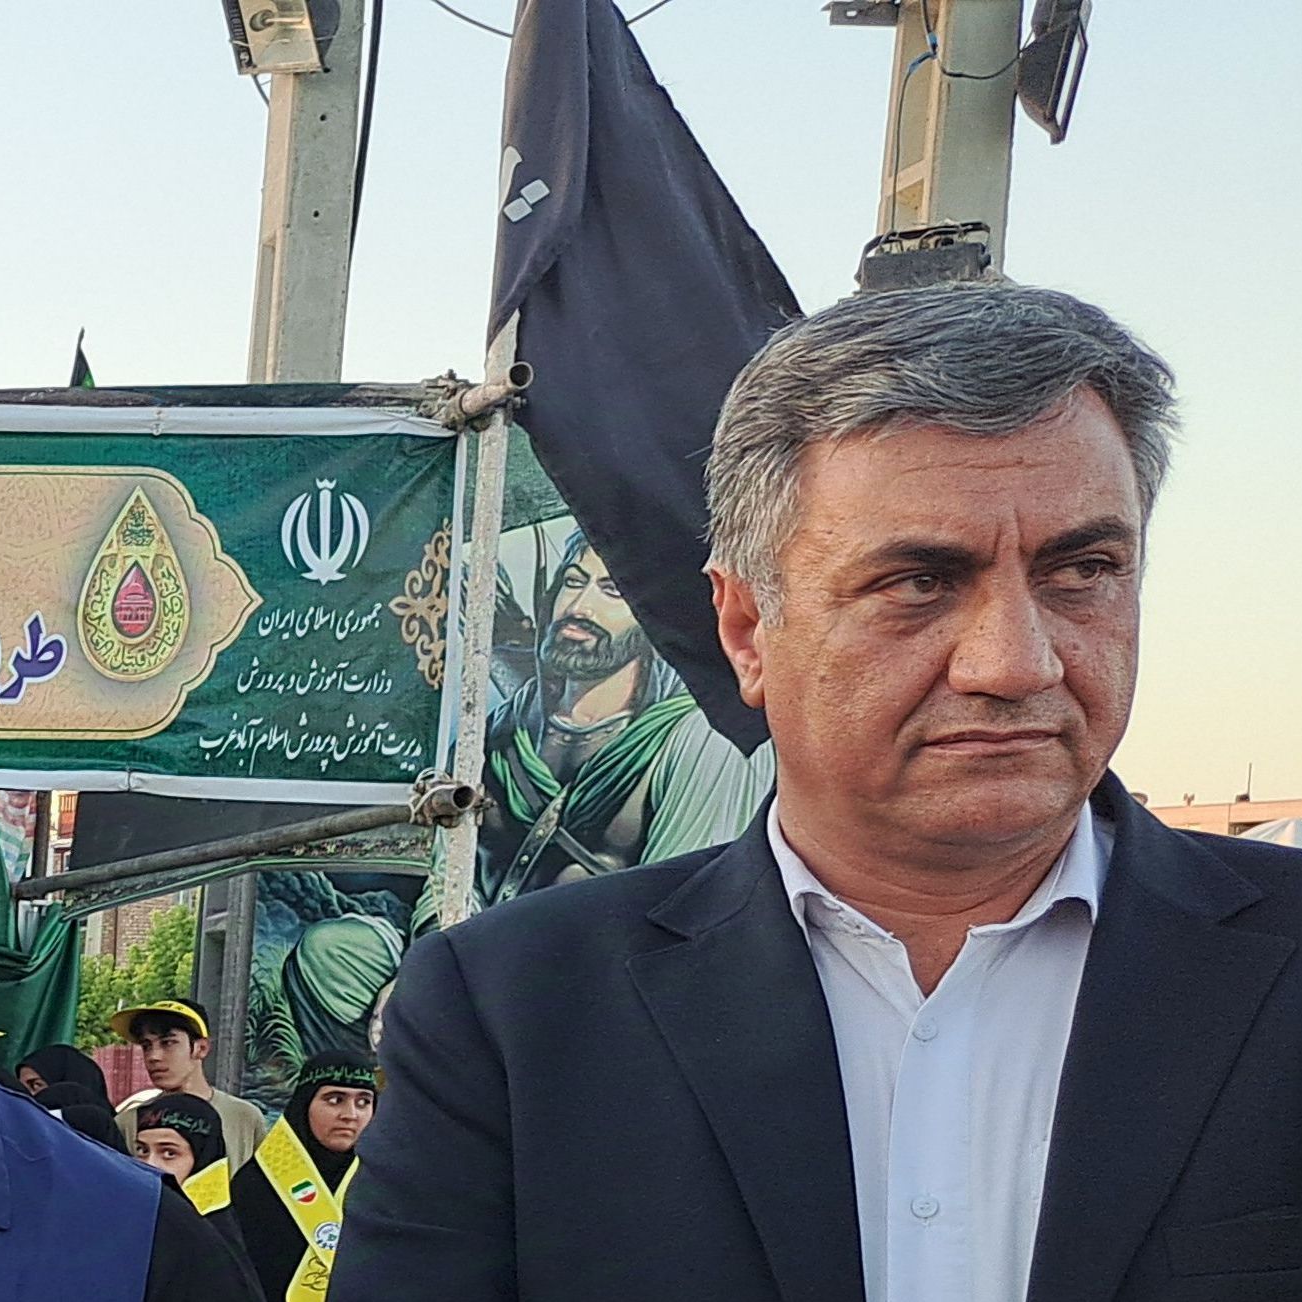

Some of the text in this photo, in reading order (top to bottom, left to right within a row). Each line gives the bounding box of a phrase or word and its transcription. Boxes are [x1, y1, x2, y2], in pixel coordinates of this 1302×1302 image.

[258, 602, 382, 640] جمهوری اسلامی ایران
[237, 656, 392, 695] وزارت آموزش و پرورش
[250, 729, 288, 775] اسلام
[334, 713, 389, 761] آموزش
[381, 734, 423, 771] مدیریت
